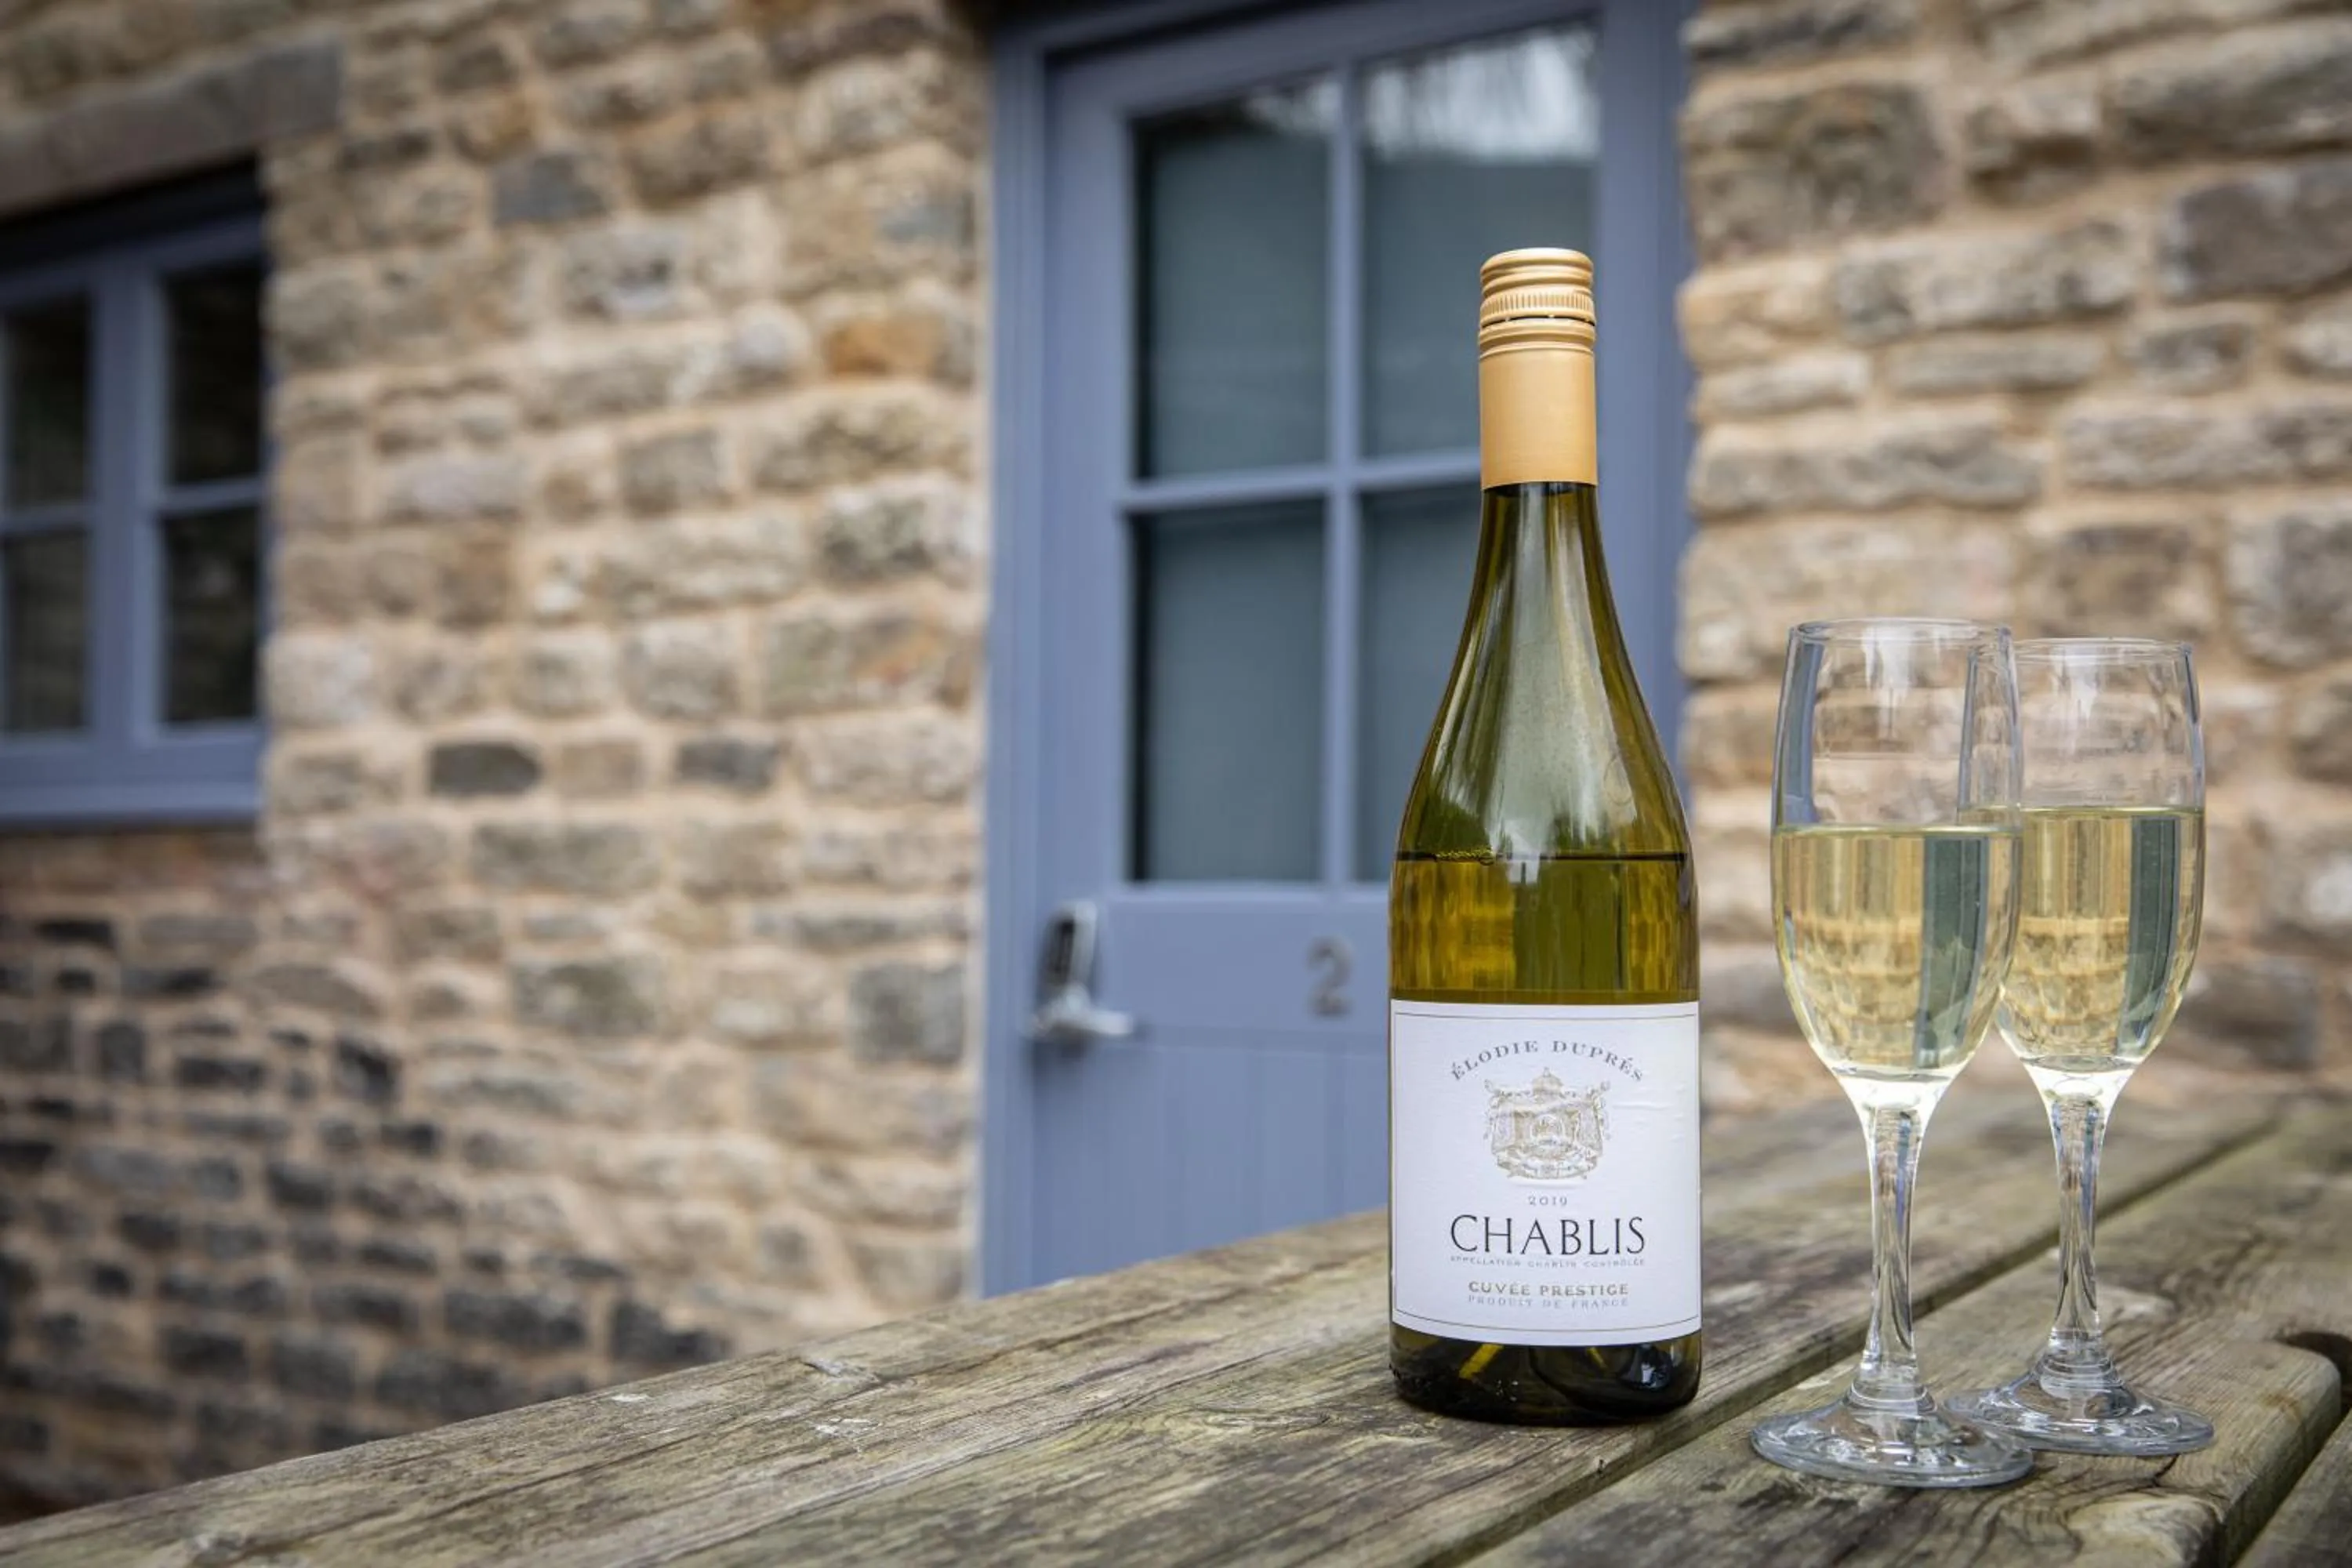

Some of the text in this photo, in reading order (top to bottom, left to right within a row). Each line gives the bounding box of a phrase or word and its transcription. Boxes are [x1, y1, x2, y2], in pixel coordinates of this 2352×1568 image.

[1308, 936, 1353, 1017] 2
[1450, 1040, 1643, 1082] ÉLODIE DUPRÉS
[1528, 1196, 1567, 1207] 2019
[1450, 1214, 1645, 1255] CHABLIS
[1468, 1280, 1629, 1297] CUVÉE PRESTIGE
[1468, 1294, 1628, 1309] PRODUIT DE FRANCE
